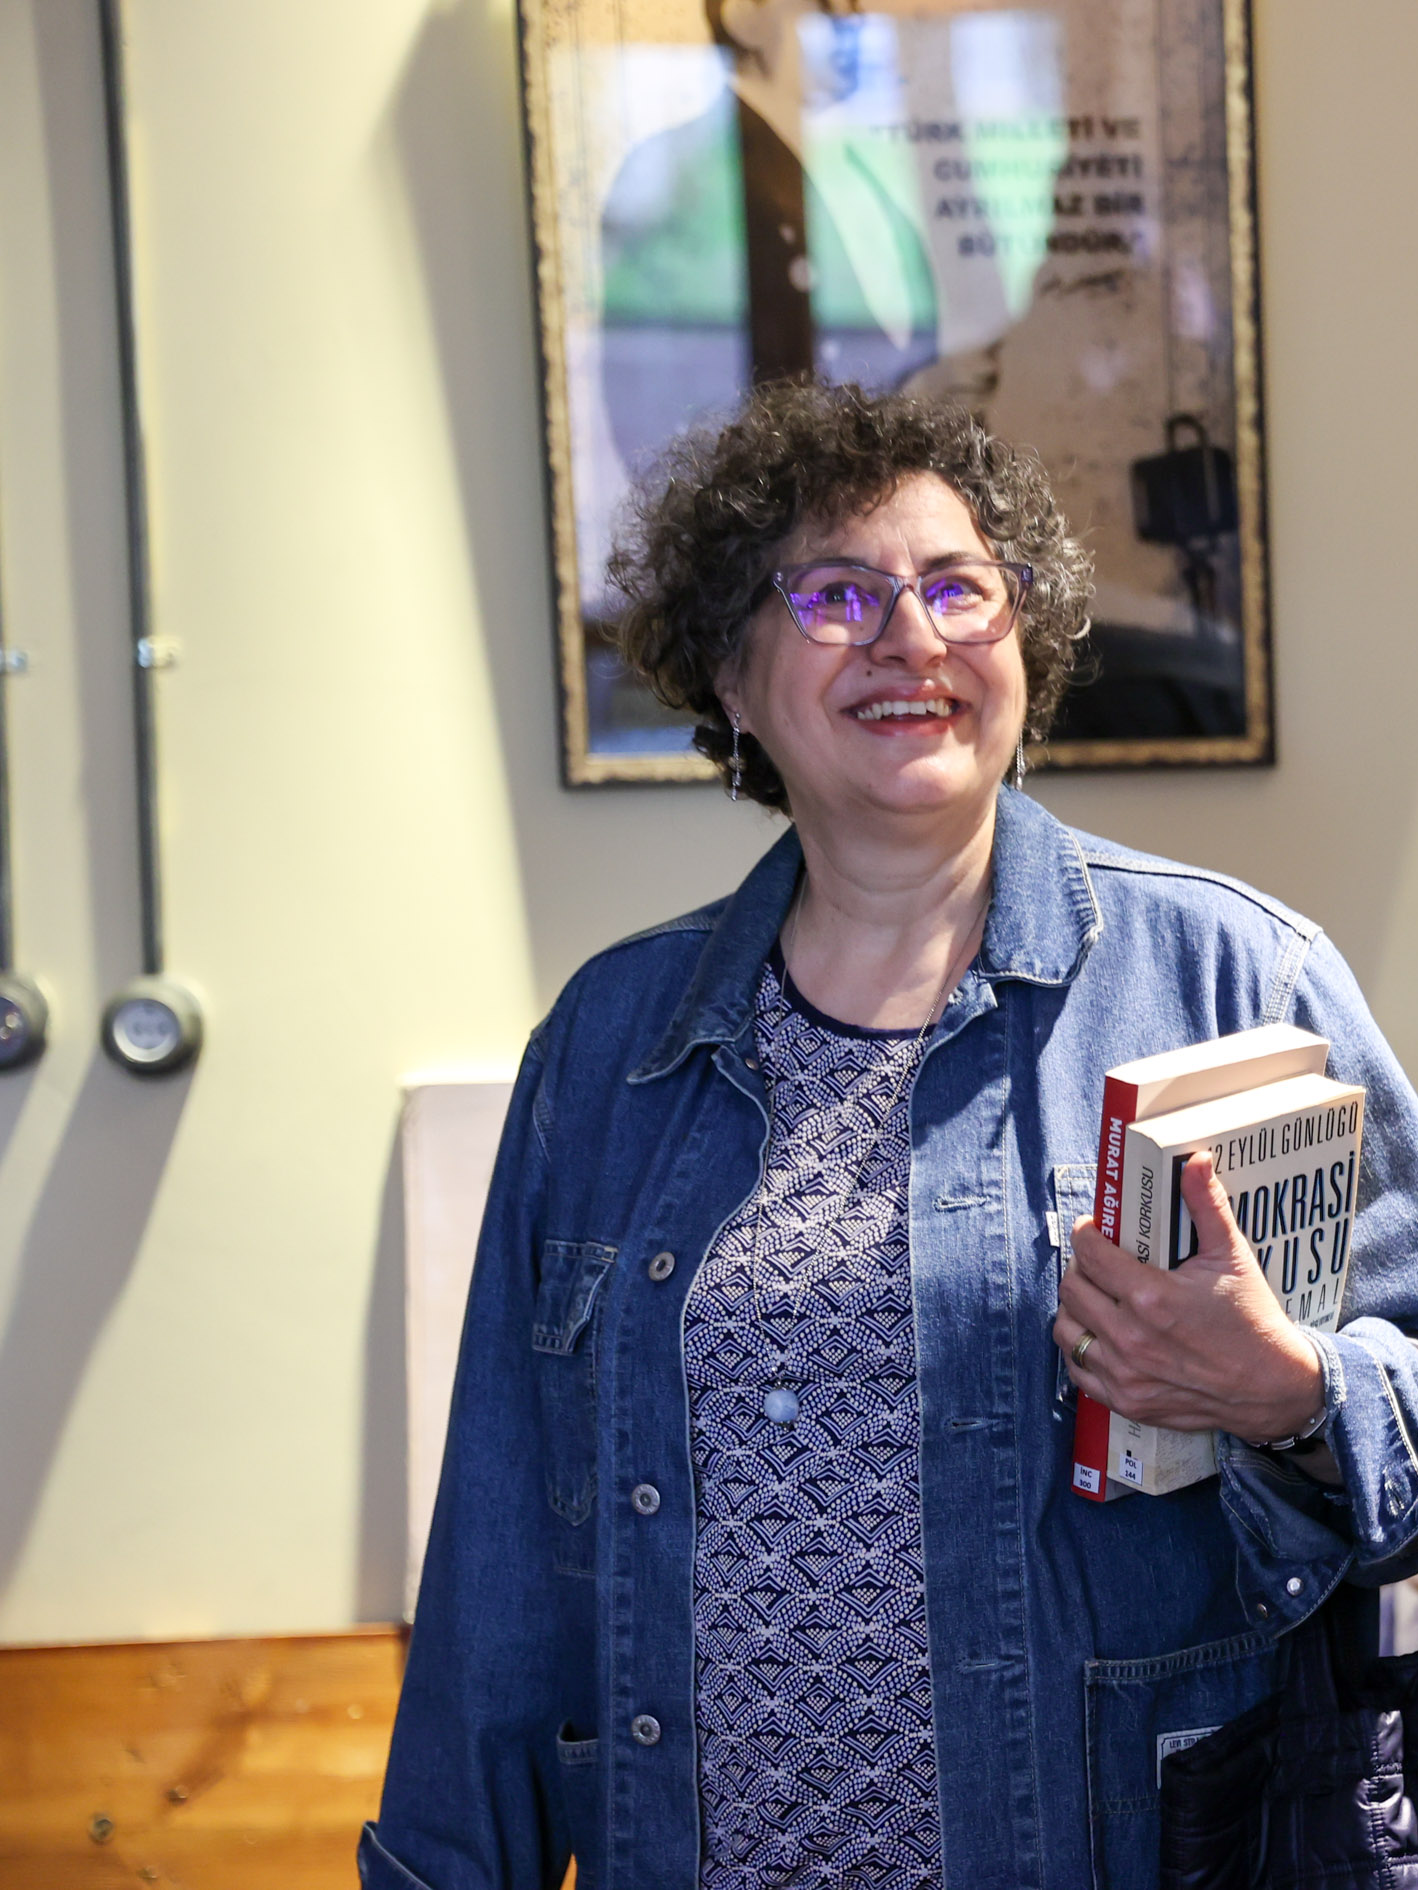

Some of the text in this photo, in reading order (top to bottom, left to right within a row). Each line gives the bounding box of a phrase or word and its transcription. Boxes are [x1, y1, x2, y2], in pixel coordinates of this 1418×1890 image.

[1102, 117, 1140, 139] VE
[1228, 1127, 1277, 1172] EYLÜL
[1101, 1117, 1123, 1243] MURAT AĞIRE
[1138, 1166, 1155, 1239] KORKUSU
[1257, 1217, 1349, 1295] KUSU
[1285, 1277, 1340, 1322] EMAL
[1125, 1458, 1137, 1470] POL
